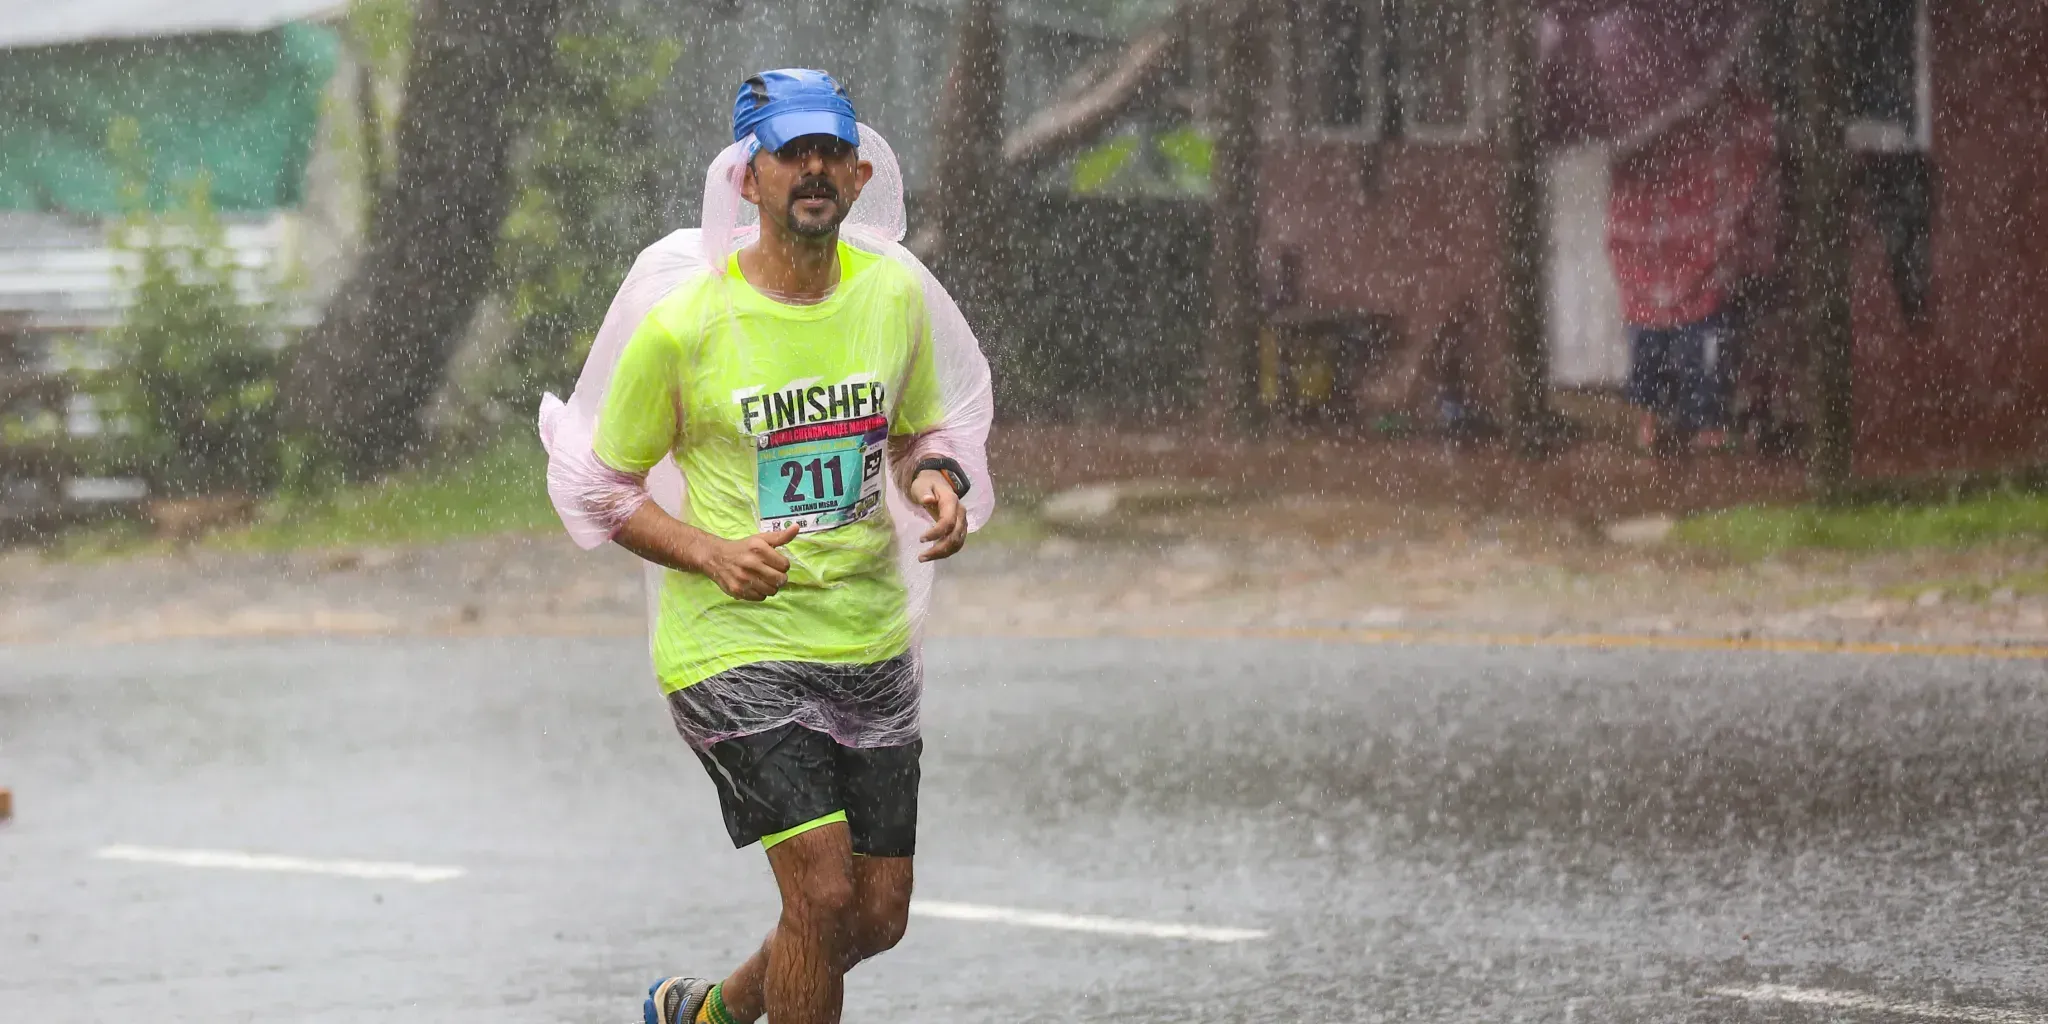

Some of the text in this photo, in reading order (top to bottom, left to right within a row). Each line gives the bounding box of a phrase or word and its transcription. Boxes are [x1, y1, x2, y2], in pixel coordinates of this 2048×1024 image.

[781, 455, 844, 503] 211
[790, 500, 839, 513] SANTANU MISRA
